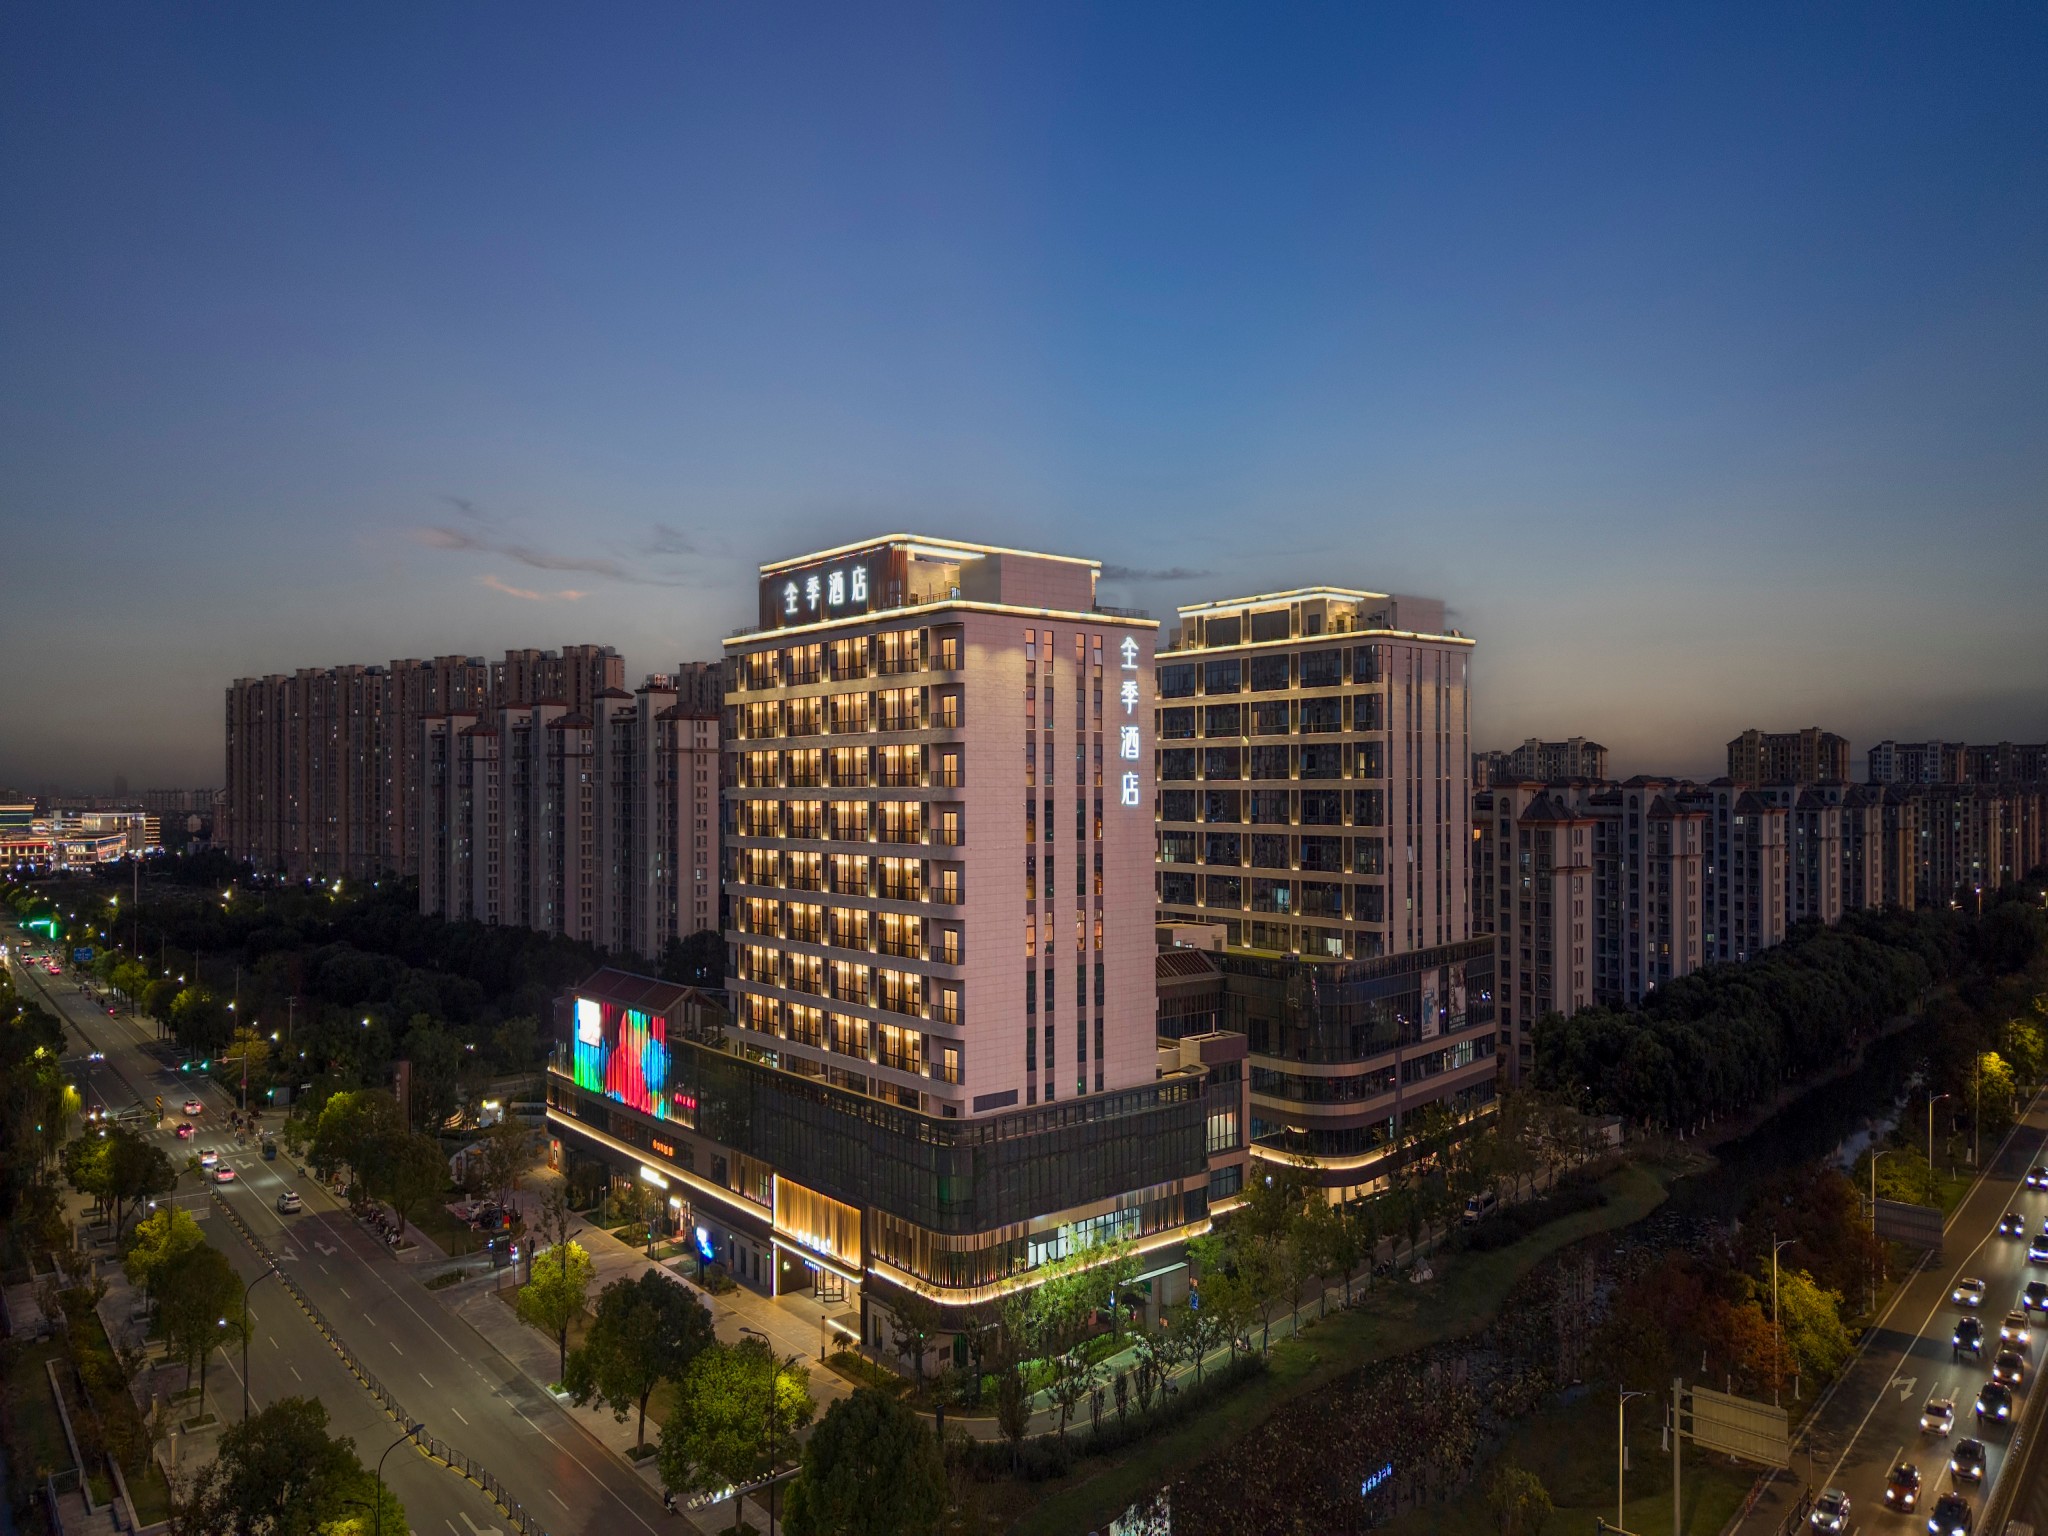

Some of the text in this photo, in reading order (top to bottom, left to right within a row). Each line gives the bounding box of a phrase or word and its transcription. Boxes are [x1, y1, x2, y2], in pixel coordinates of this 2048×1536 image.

[783, 565, 866, 613] 全季酒店
[1120, 636, 1139, 805] 全季酒店
